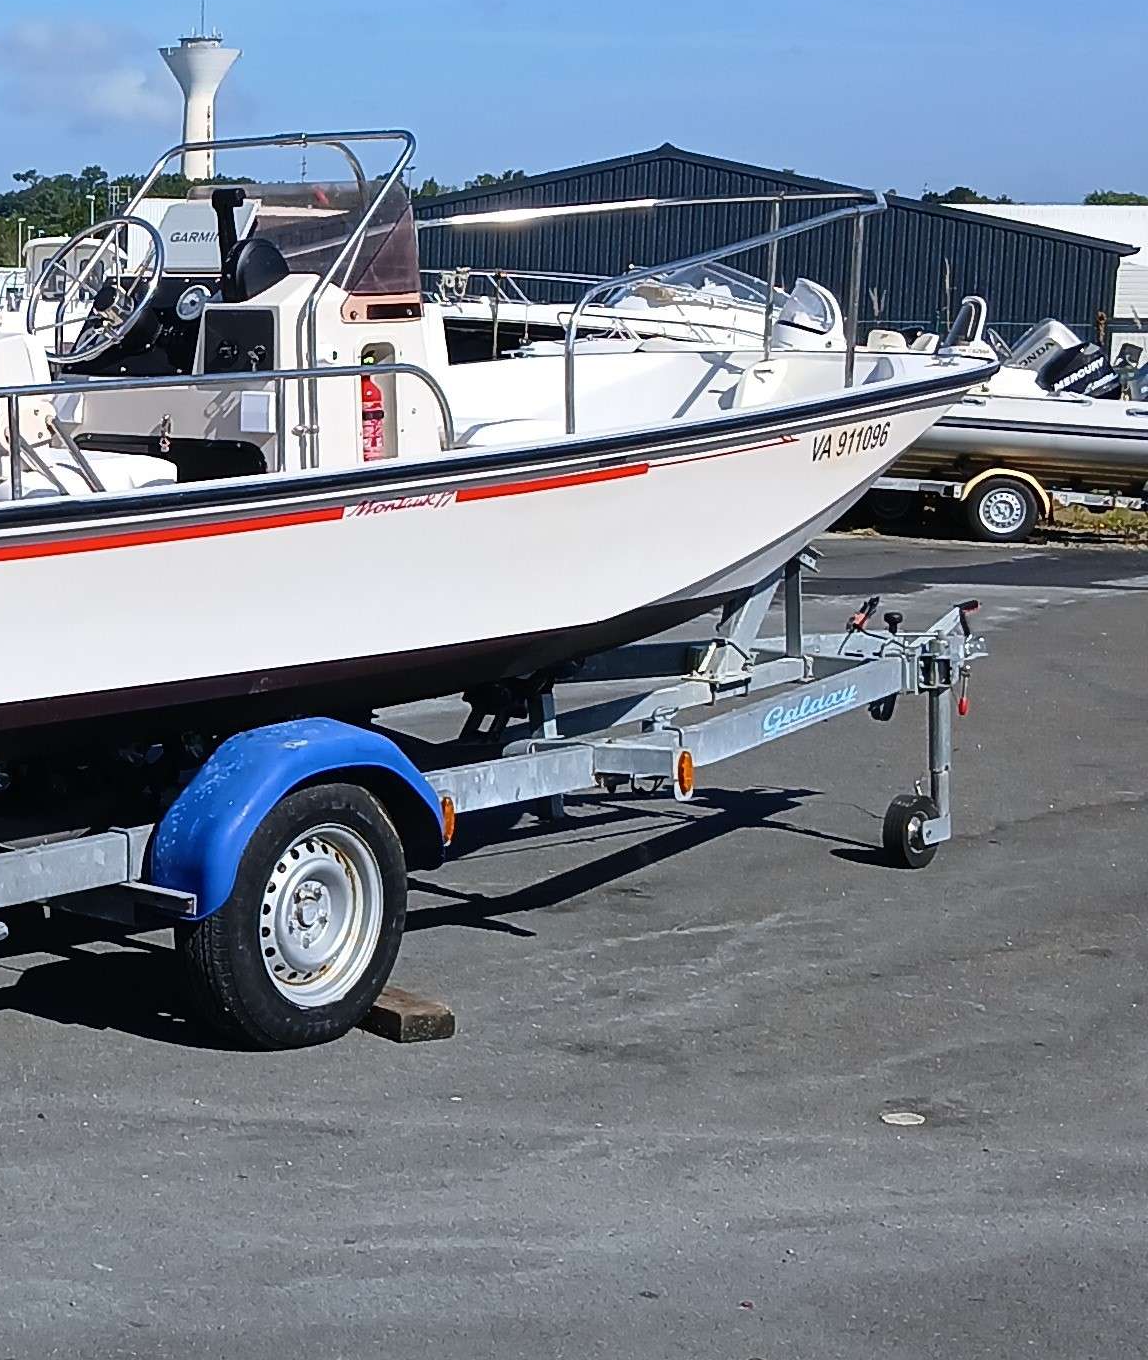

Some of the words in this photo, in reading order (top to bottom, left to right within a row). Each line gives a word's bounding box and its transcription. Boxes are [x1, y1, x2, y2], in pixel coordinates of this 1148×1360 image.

[1019, 342, 1055, 366] ONDA
[1053, 356, 1104, 392] MERCURY
[812, 434, 832, 462] VA
[836, 421, 891, 456] 911096
[763, 684, 858, 734] Galaxy
